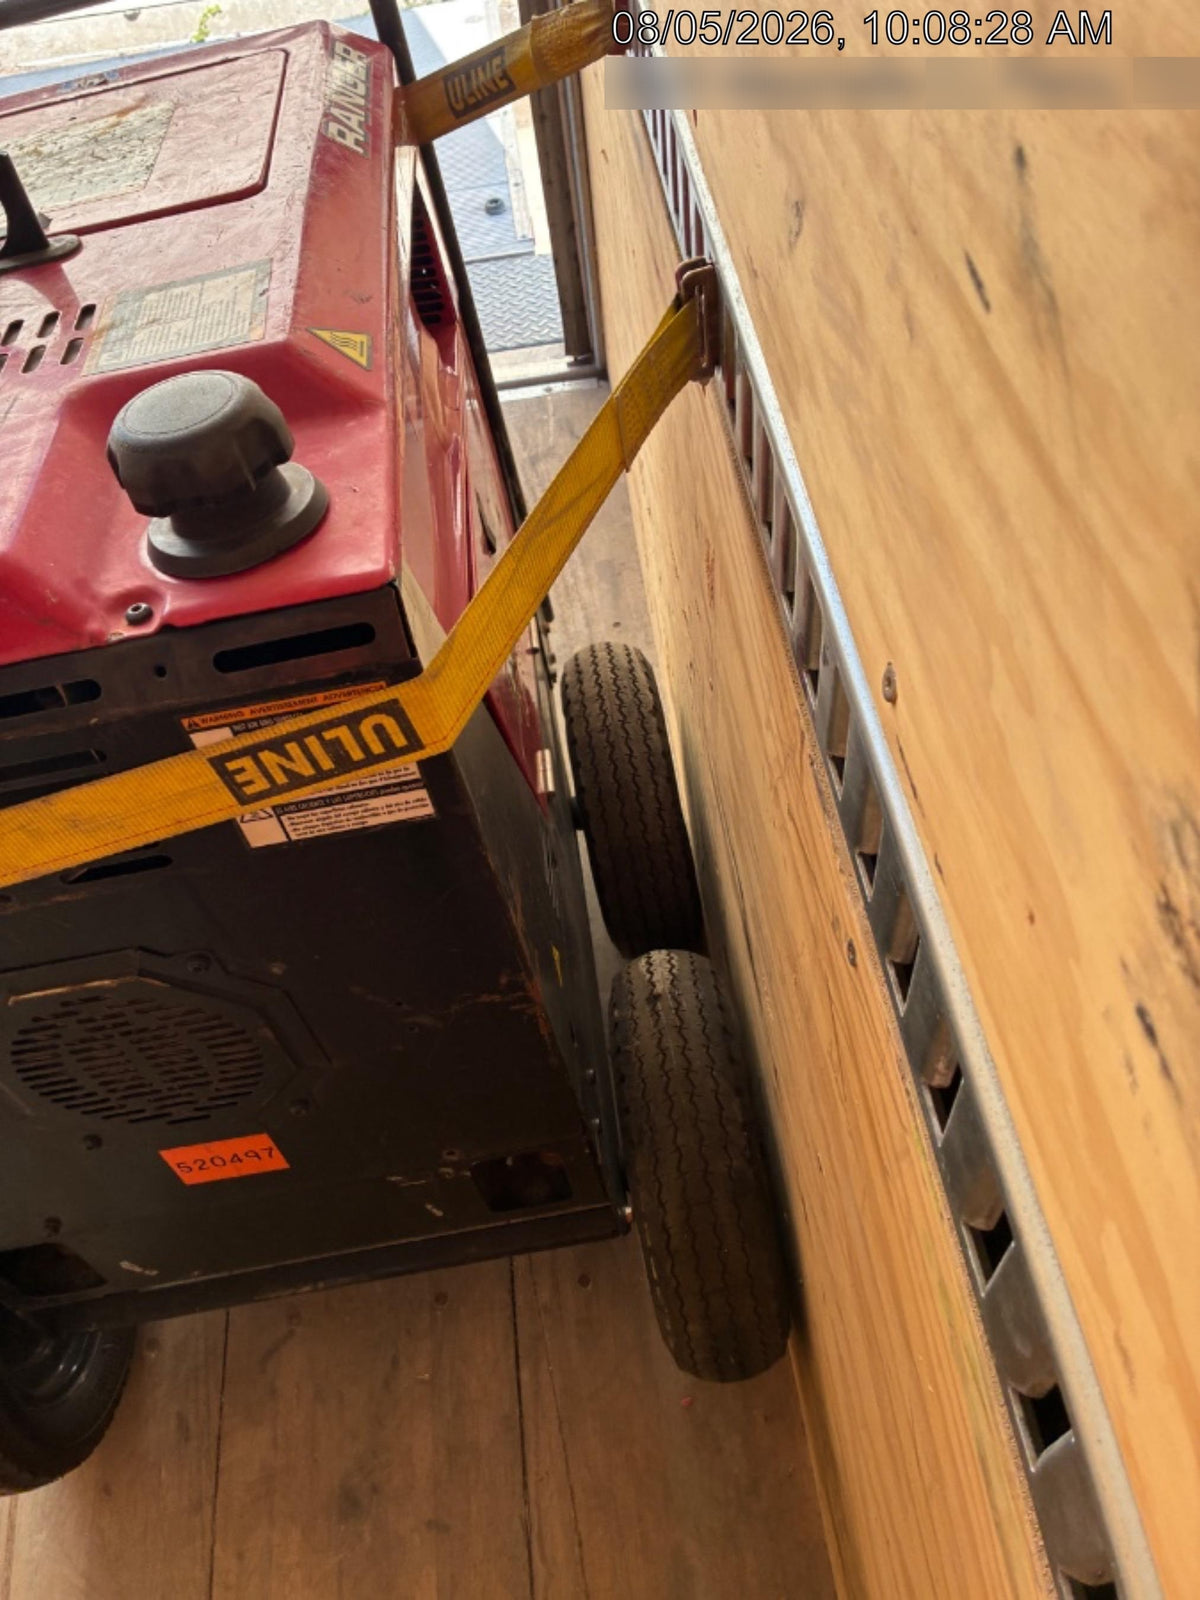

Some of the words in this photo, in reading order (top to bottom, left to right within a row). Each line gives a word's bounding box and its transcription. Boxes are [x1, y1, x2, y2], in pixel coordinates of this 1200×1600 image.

[327, 41, 368, 158] RANGER
[447, 57, 510, 112] ULINE
[201, 711, 245, 724] WARNING
[225, 713, 408, 796] ULINE
[176, 1146, 274, 1174] 520497
